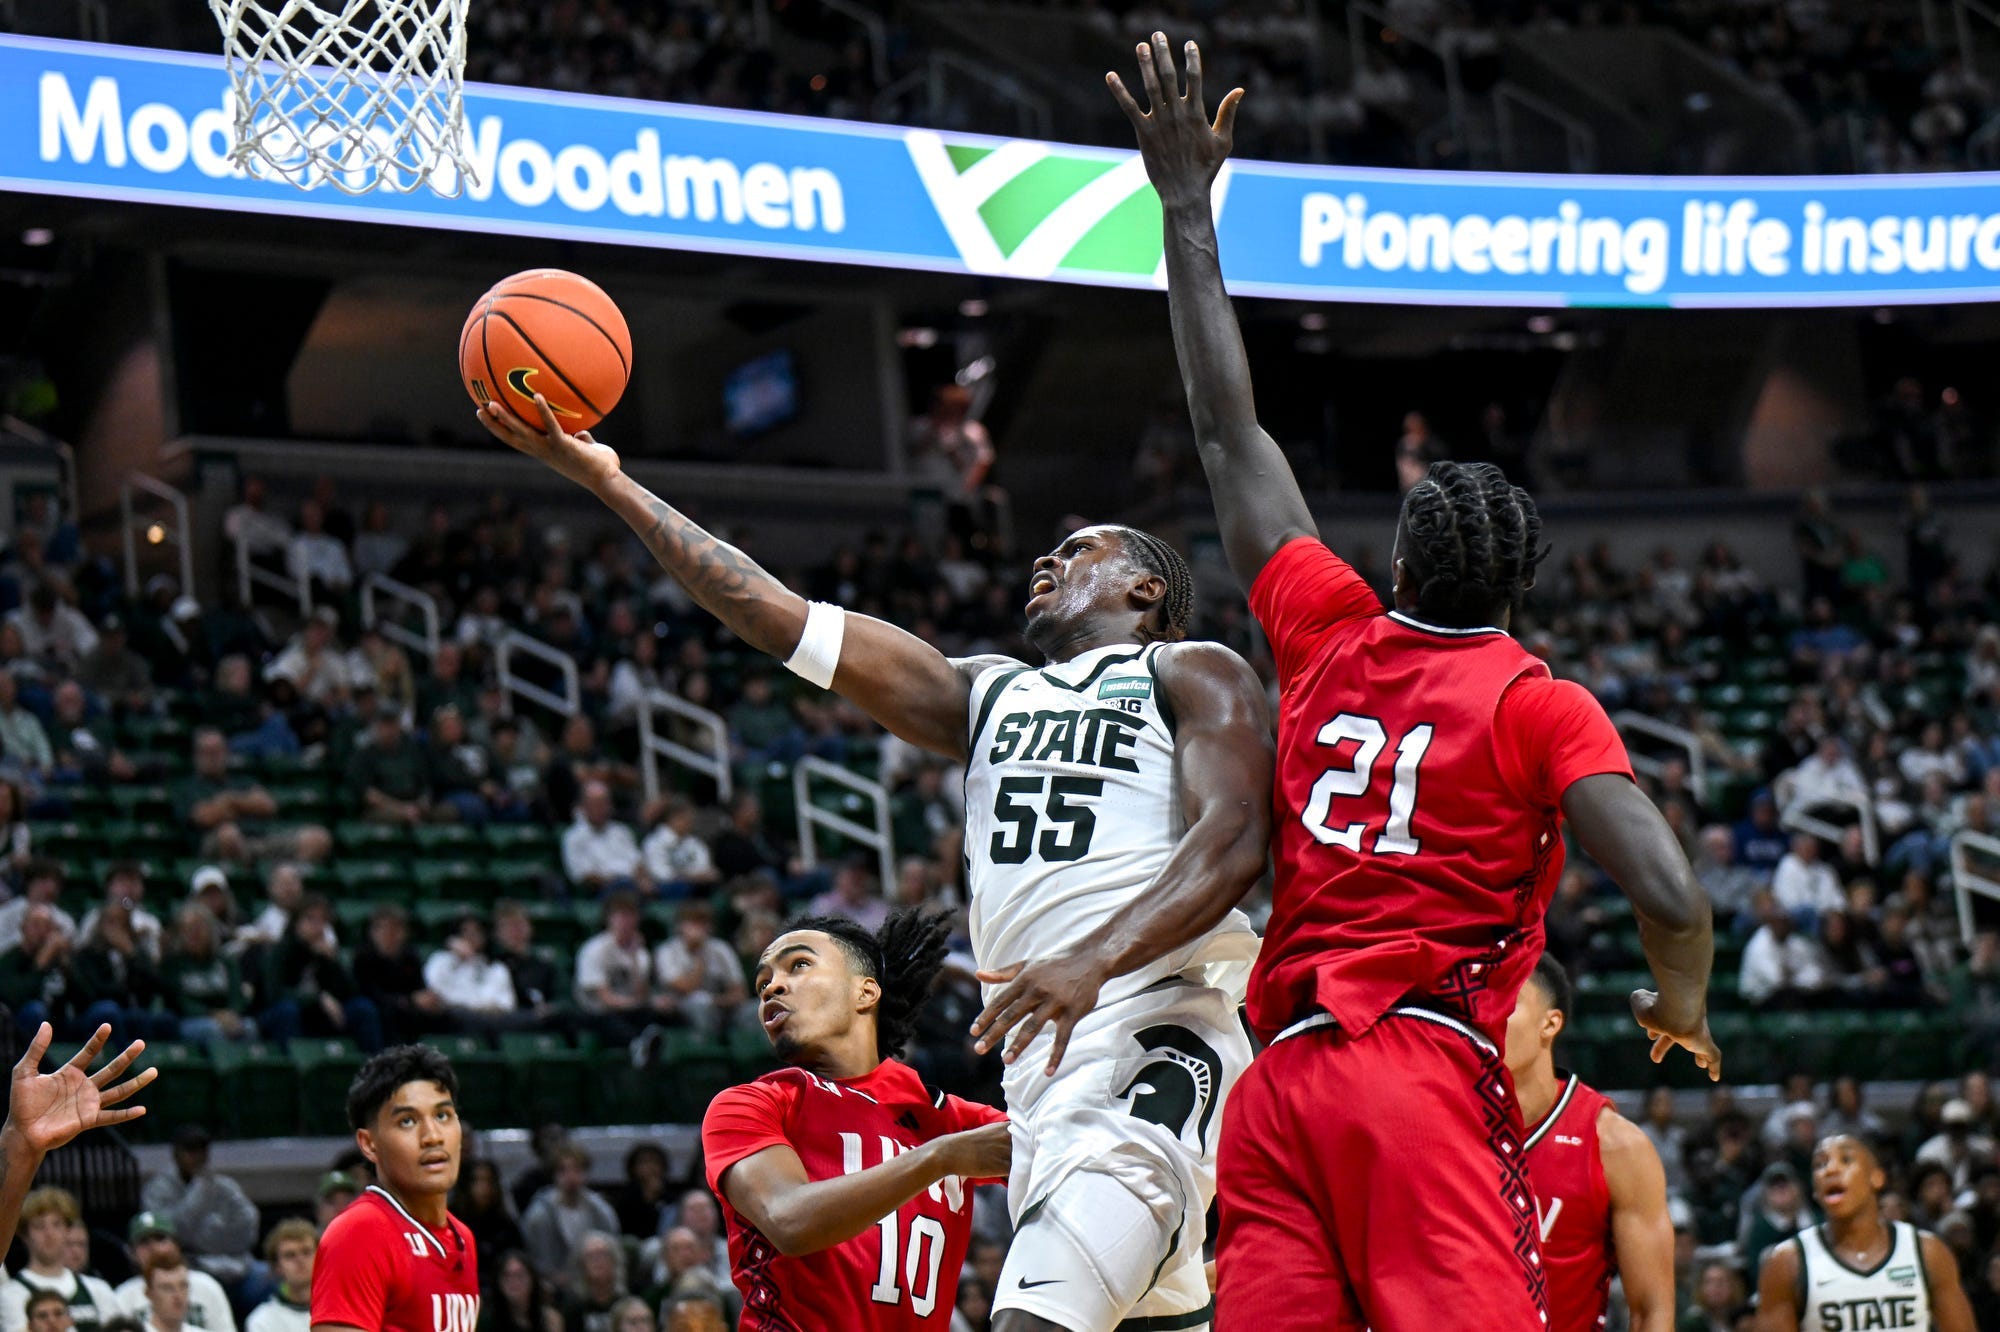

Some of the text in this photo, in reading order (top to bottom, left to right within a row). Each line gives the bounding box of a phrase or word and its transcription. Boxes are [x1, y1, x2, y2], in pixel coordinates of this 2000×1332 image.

[411, 106, 846, 234] Woodmen
[1300, 192, 1670, 295] Pioneering
[1681, 198, 1791, 277] life
[989, 709, 1149, 774] STATE
[1301, 711, 1435, 856] 21
[990, 775, 1104, 864] 55
[872, 1208, 946, 1318] 10
[1819, 1296, 1917, 1332] STATE
